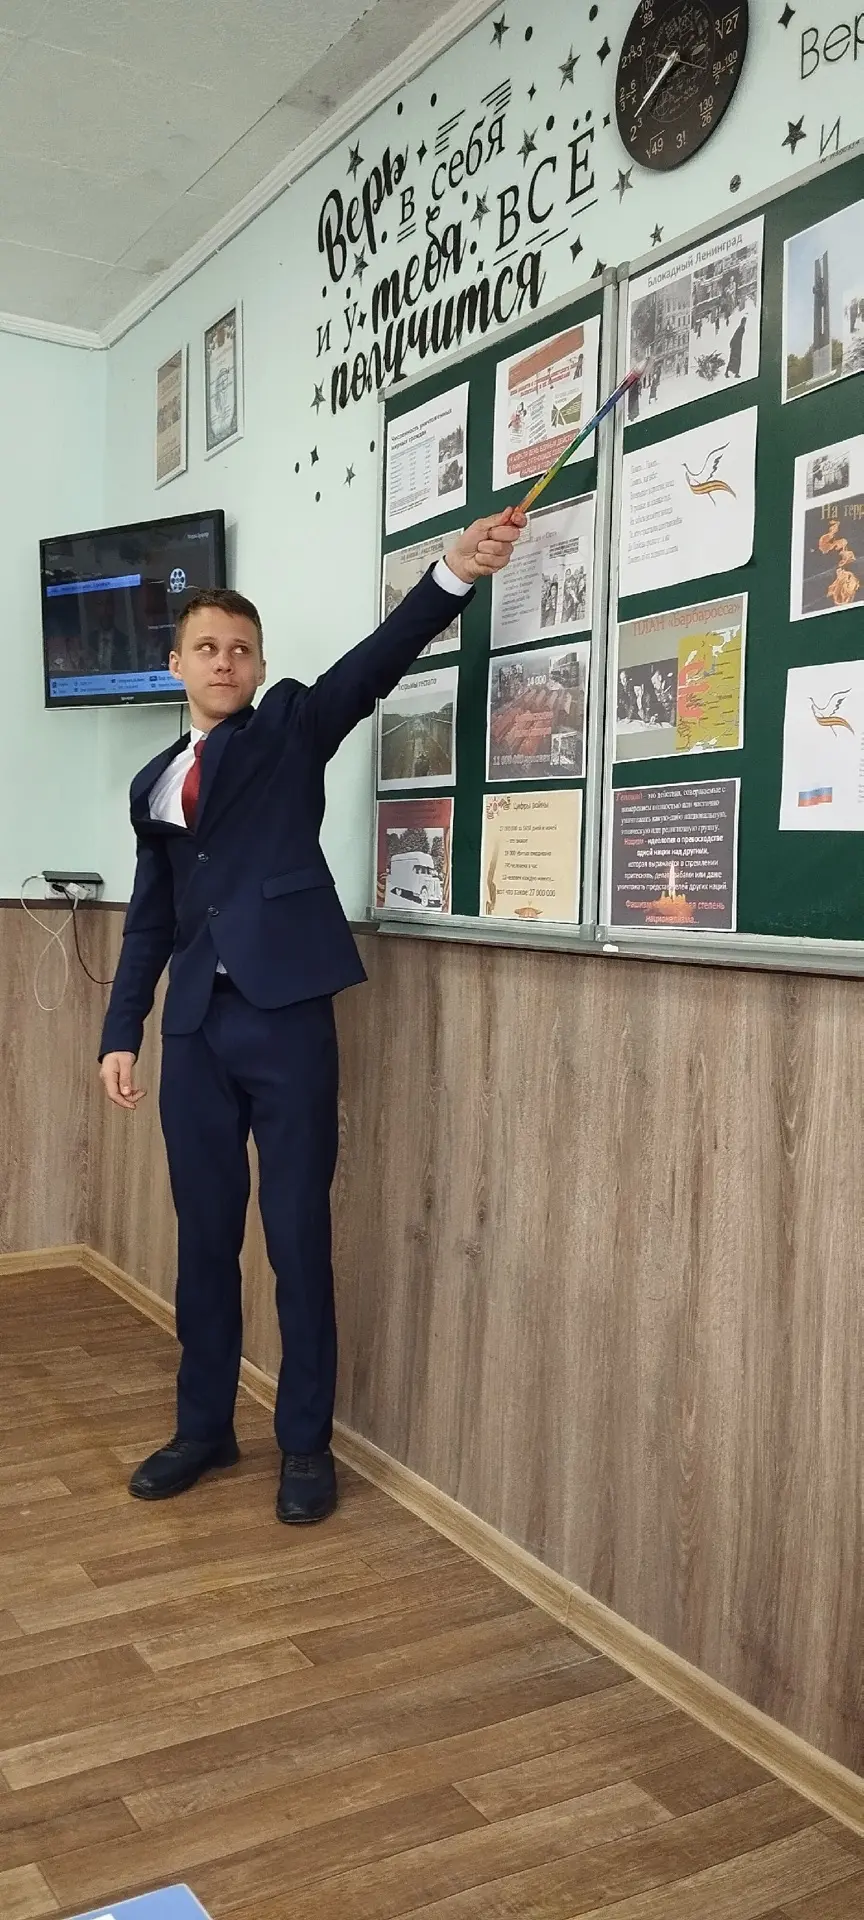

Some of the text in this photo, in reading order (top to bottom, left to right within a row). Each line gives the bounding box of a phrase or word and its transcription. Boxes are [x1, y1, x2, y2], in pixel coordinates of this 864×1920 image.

[316, 109, 595, 358] и у тебя ВСЁ
[318, 144, 409, 283] Верь
[432, 113, 506, 201] себя
[648, 233, 743, 288] Блокадный Ленинград
[331, 250, 547, 415] получится
[820, 503, 838, 520] На
[632, 617, 664, 636] ПЛАН
